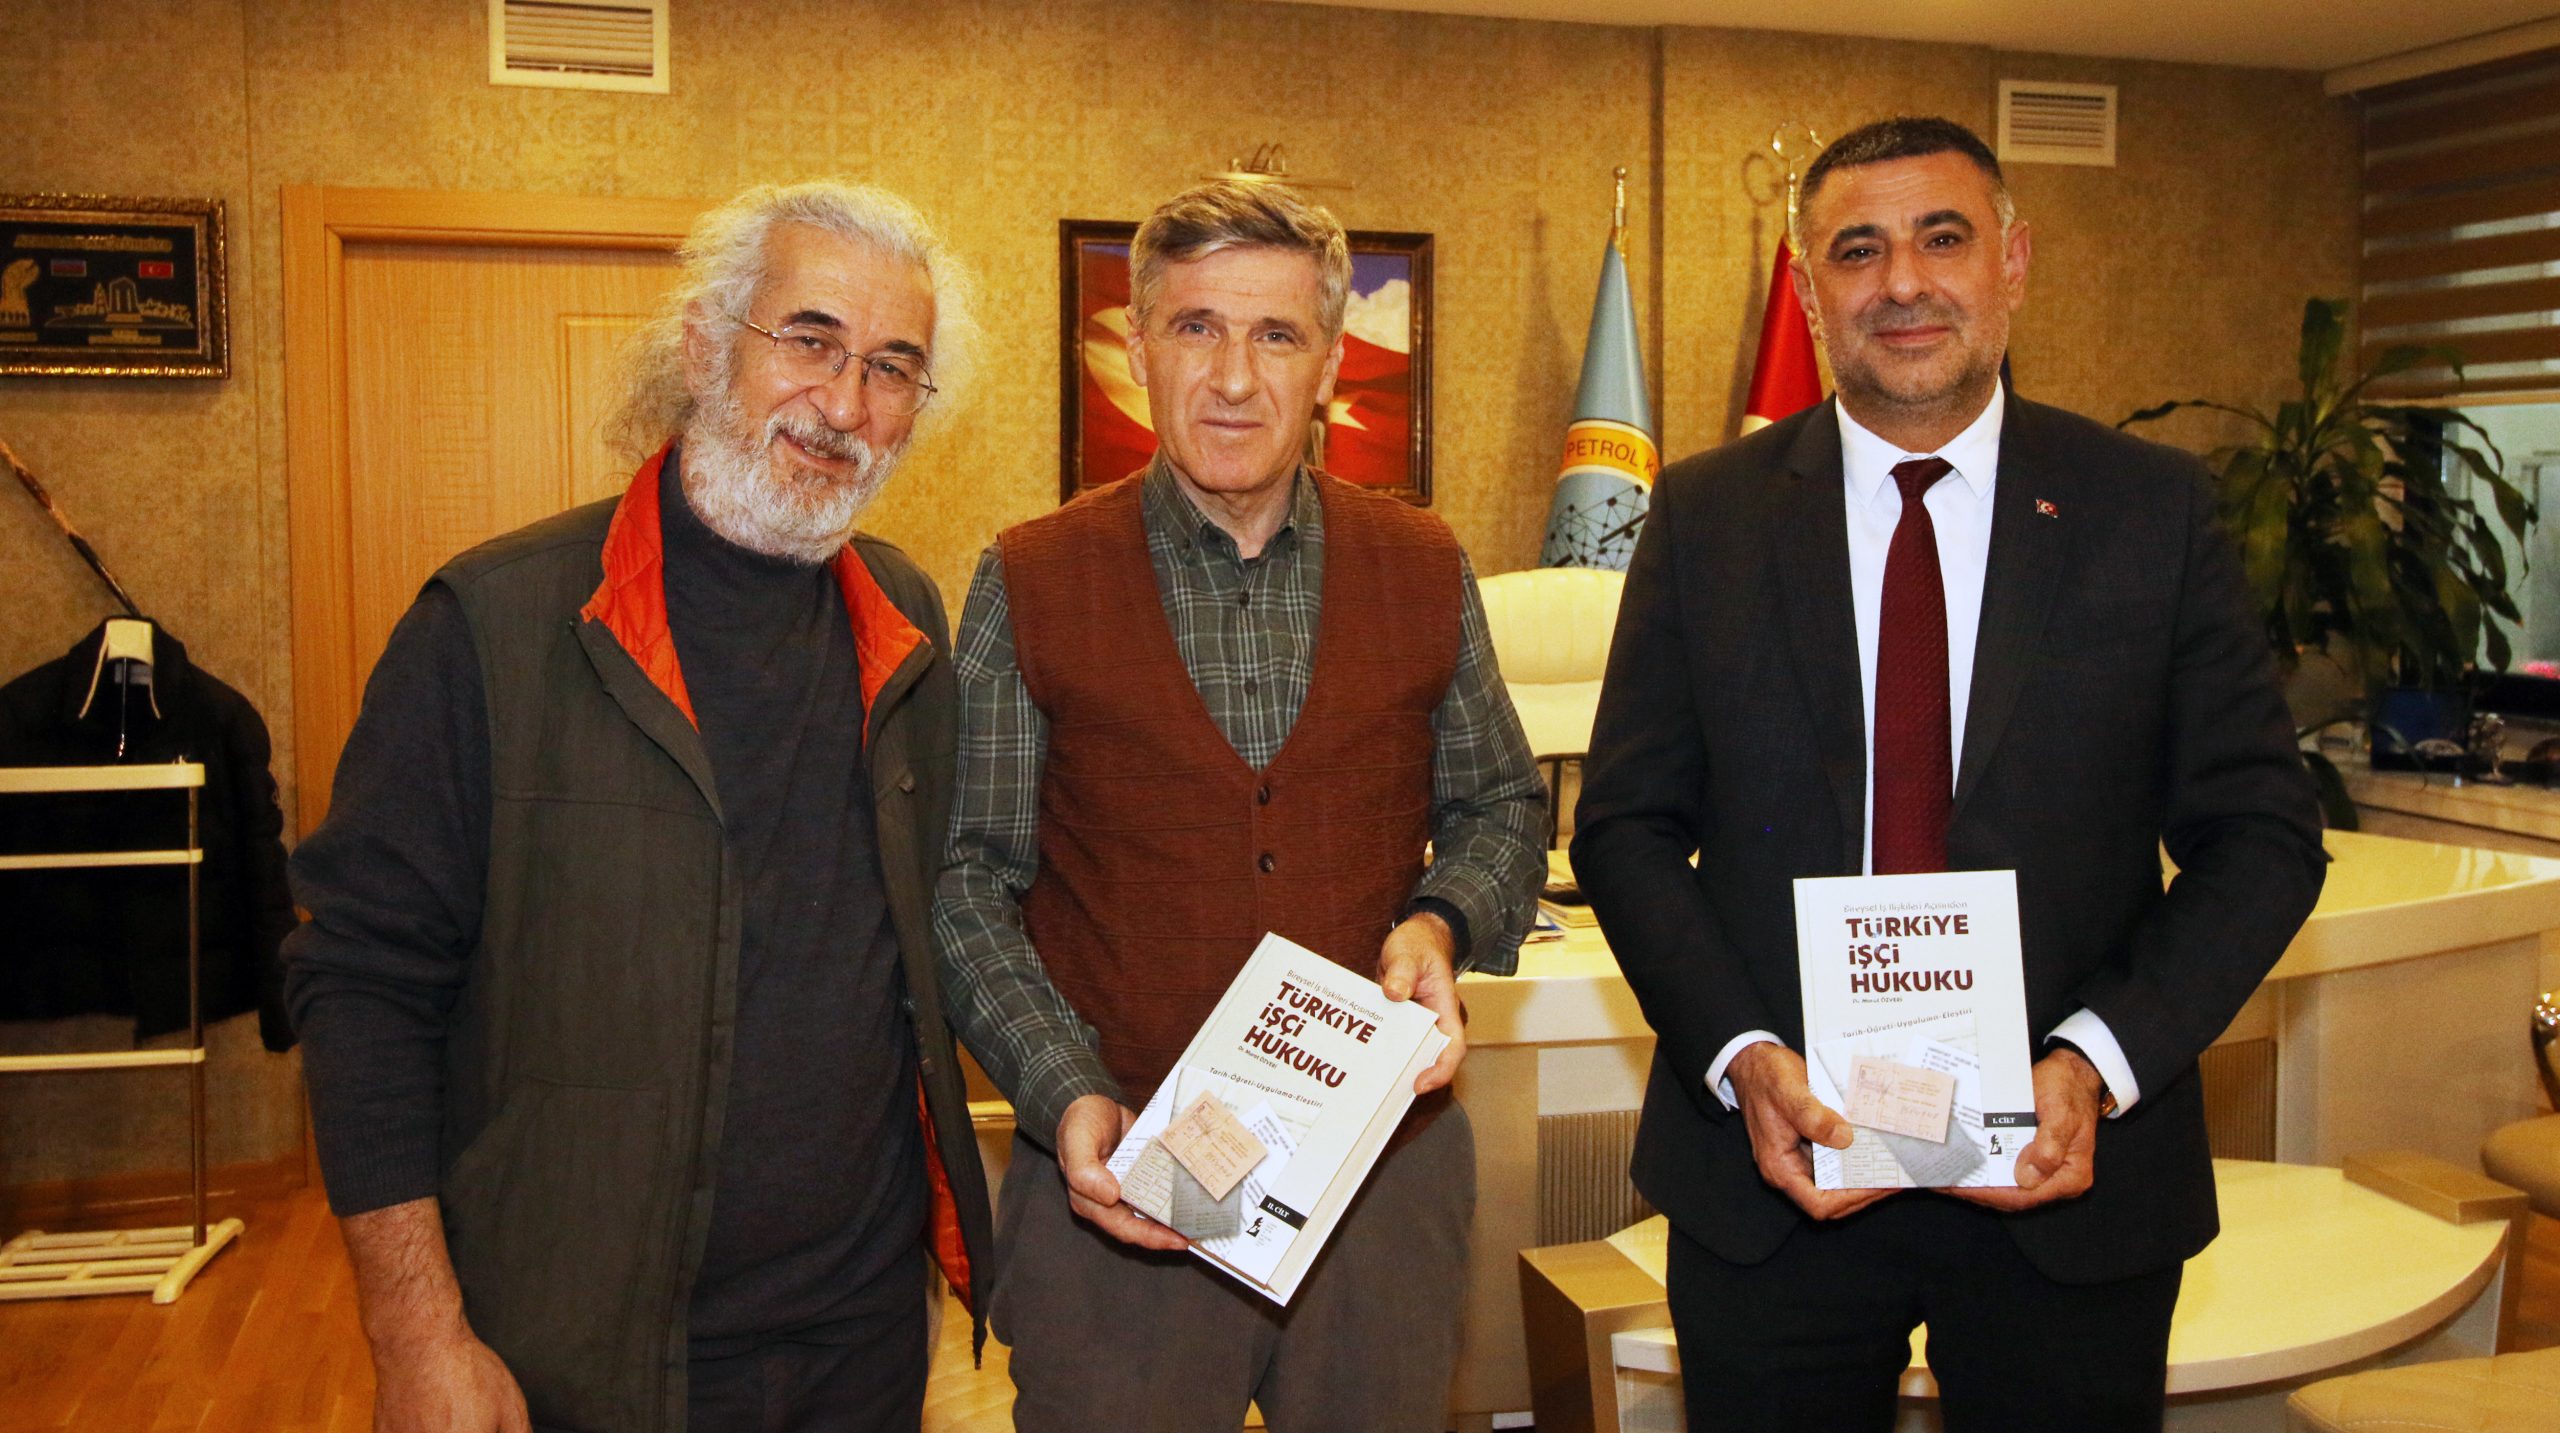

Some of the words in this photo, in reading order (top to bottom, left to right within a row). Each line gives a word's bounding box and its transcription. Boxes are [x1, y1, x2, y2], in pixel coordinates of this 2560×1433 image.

[1566, 438, 1638, 468] PETROL
[1845, 914, 1969, 939] TÜRKİYE
[1848, 943, 1900, 970] İŞÇİ
[1850, 969, 1974, 994] HUKUKU
[1259, 1001, 1307, 1038] İŞÇİ
[1277, 980, 1377, 1044] TÜRKİYE
[1348, 999, 1385, 1023] Açısından
[1243, 1024, 1347, 1089] HUKUKU
[1998, 1115, 2016, 1124] CİLT
[1274, 1206, 1290, 1219] CİLT
